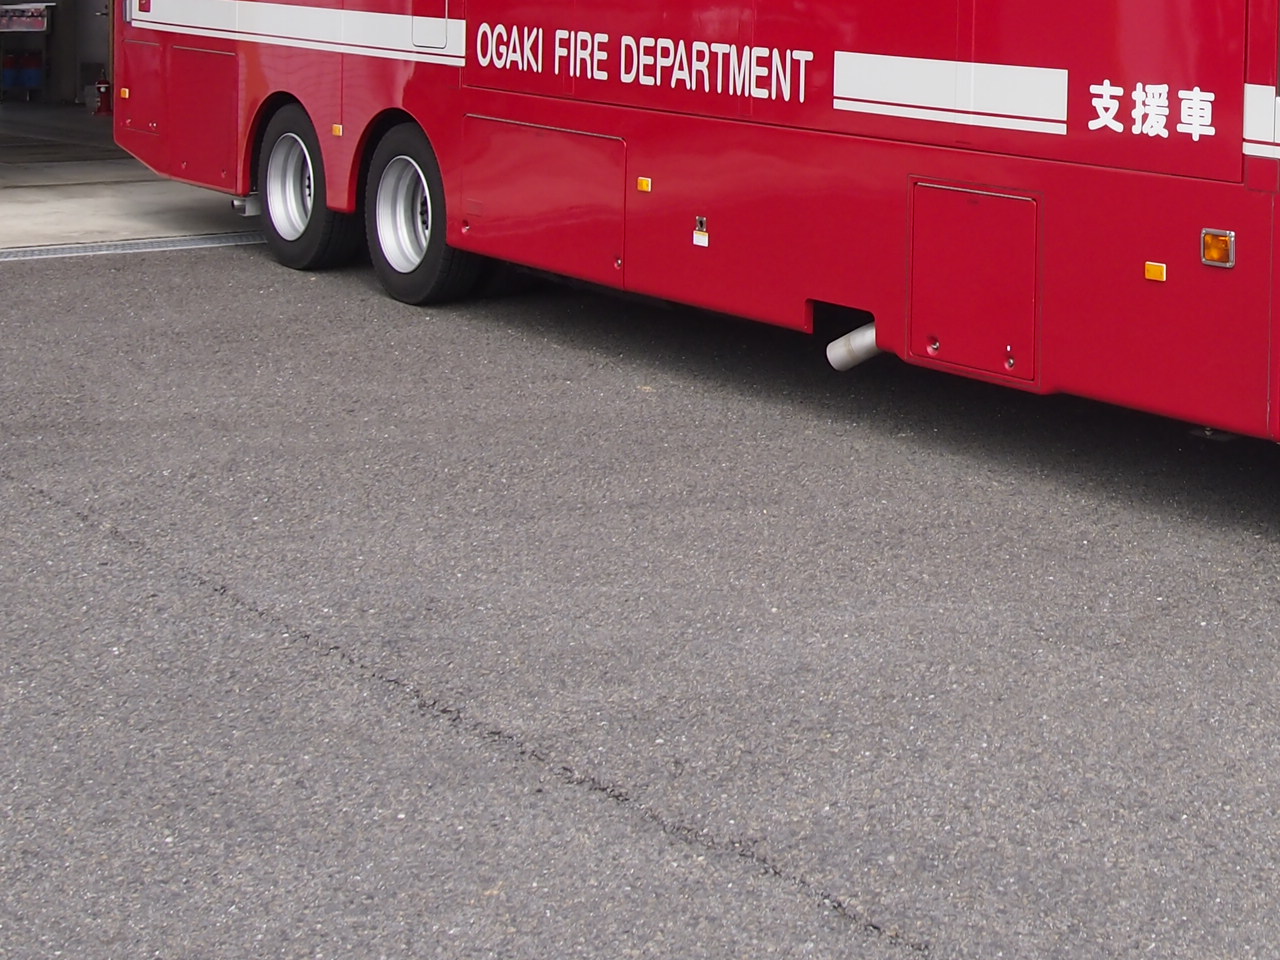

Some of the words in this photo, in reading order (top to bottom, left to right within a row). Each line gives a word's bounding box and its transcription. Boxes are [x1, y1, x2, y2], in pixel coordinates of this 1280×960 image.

[476, 22, 543, 74] OGAKI
[554, 29, 609, 81] FIRE
[620, 35, 814, 104] DEPARTMENT
[1087, 78, 1216, 142] 支援車
